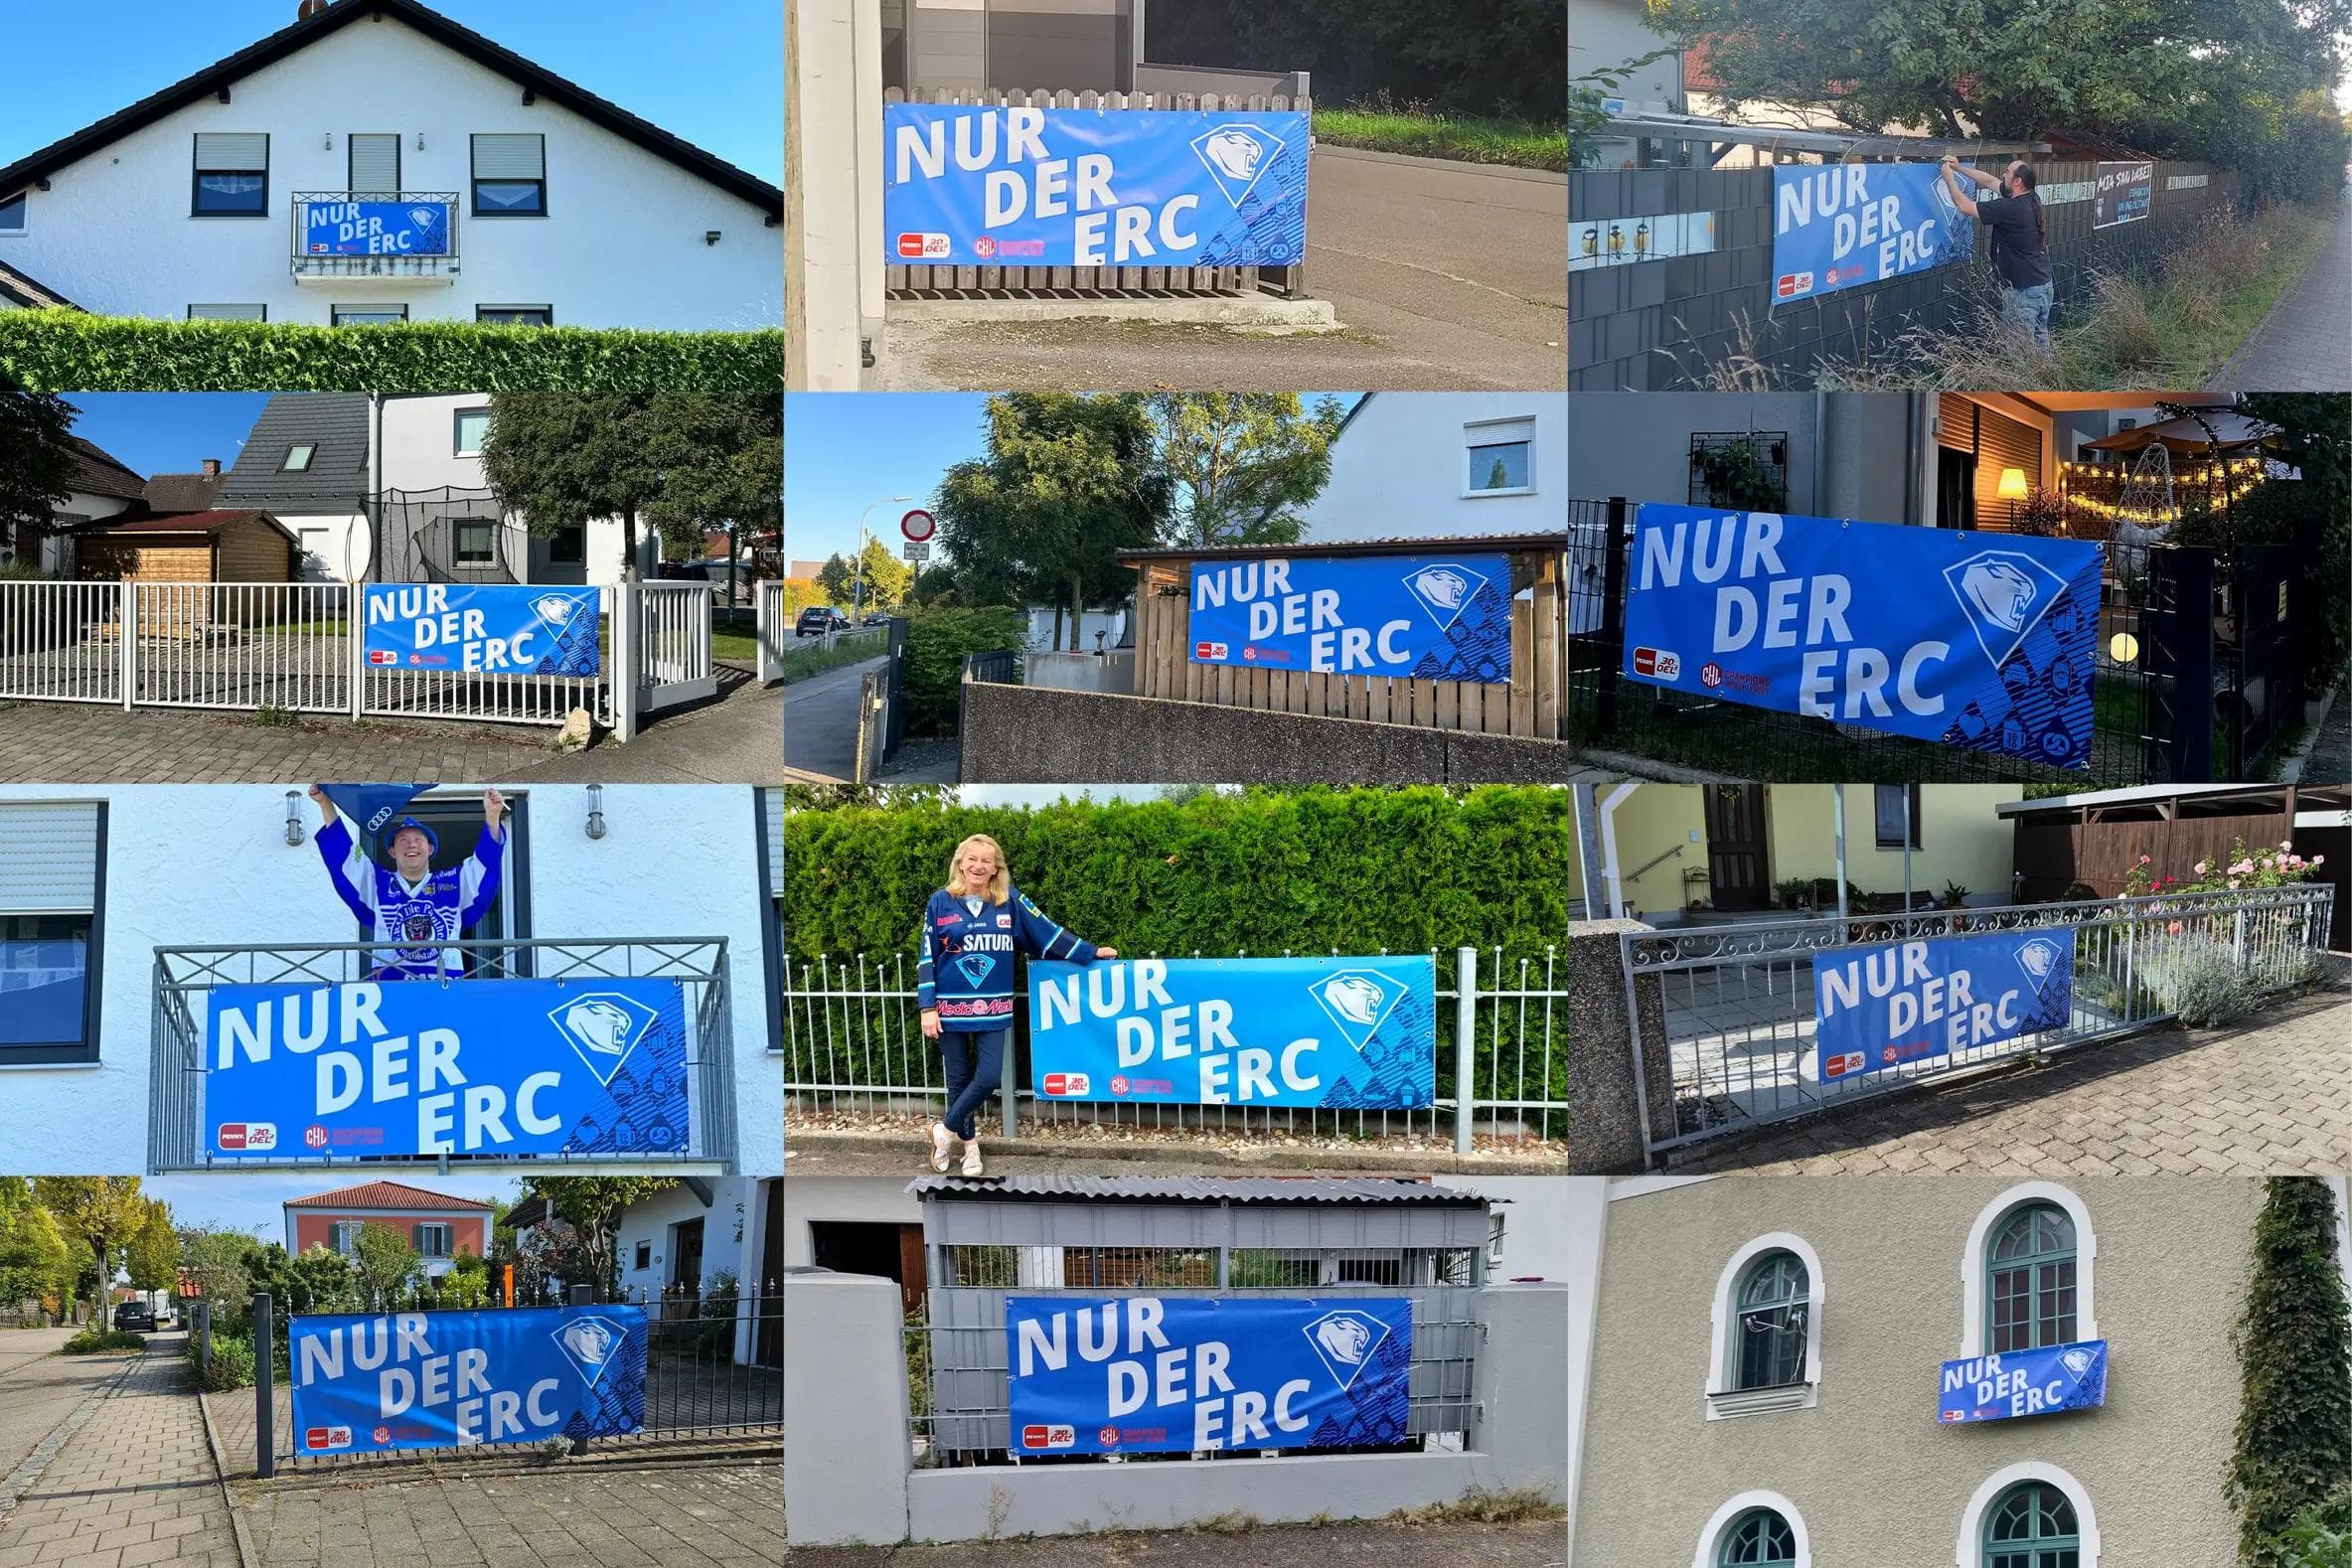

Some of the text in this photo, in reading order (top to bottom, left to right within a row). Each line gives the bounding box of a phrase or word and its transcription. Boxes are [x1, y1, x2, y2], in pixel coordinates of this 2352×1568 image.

[896, 107, 1049, 184] NUR
[311, 203, 361, 228] NUR
[985, 154, 1119, 229] DER
[1779, 164, 1868, 235] NUR
[340, 217, 384, 241] DER
[370, 231, 410, 254] ERC
[976, 236, 994, 256] CHL
[1075, 195, 1199, 266] ERC
[1833, 195, 1902, 261] DER
[1879, 220, 1936, 280] ERC
[1640, 513, 1786, 590] NUR
[370, 584, 449, 624] NUR
[1196, 559, 1292, 610] NUR
[1250, 589, 1343, 641] DER
[1713, 573, 1852, 653] DER
[414, 608, 487, 649] DER
[463, 633, 535, 672] ERC
[1311, 620, 1411, 672] ERC
[1656, 664, 1677, 674] DEL
[1701, 665, 1721, 687] CHL
[1800, 641, 1950, 719] ERC
[1039, 960, 1174, 1030] NUR
[1821, 942, 1933, 1018] NUR
[1890, 970, 1974, 1039] DER
[218, 984, 390, 1070] NUR
[1117, 999, 1239, 1068] DER
[1948, 990, 2018, 1054] ERC
[316, 1028, 467, 1116] DER
[1112, 1077, 1128, 1093] CHL
[1198, 1038, 1320, 1104] ERC
[248, 1135, 274, 1144] DEL
[306, 1127, 326, 1149] CHL
[418, 1071, 560, 1153] ERC
[300, 1313, 433, 1386] NUR
[1018, 1298, 1170, 1377] NUR
[380, 1348, 492, 1419] DER
[1108, 1341, 1235, 1418] DER
[1945, 1354, 2003, 1392] NUR
[1977, 1369, 2028, 1406] DER
[2011, 1380, 2062, 1417] ERC
[374, 1427, 390, 1443] CHL
[457, 1379, 559, 1446] ERC
[1101, 1429, 1118, 1444] CHL
[1194, 1379, 1311, 1451] ERC
